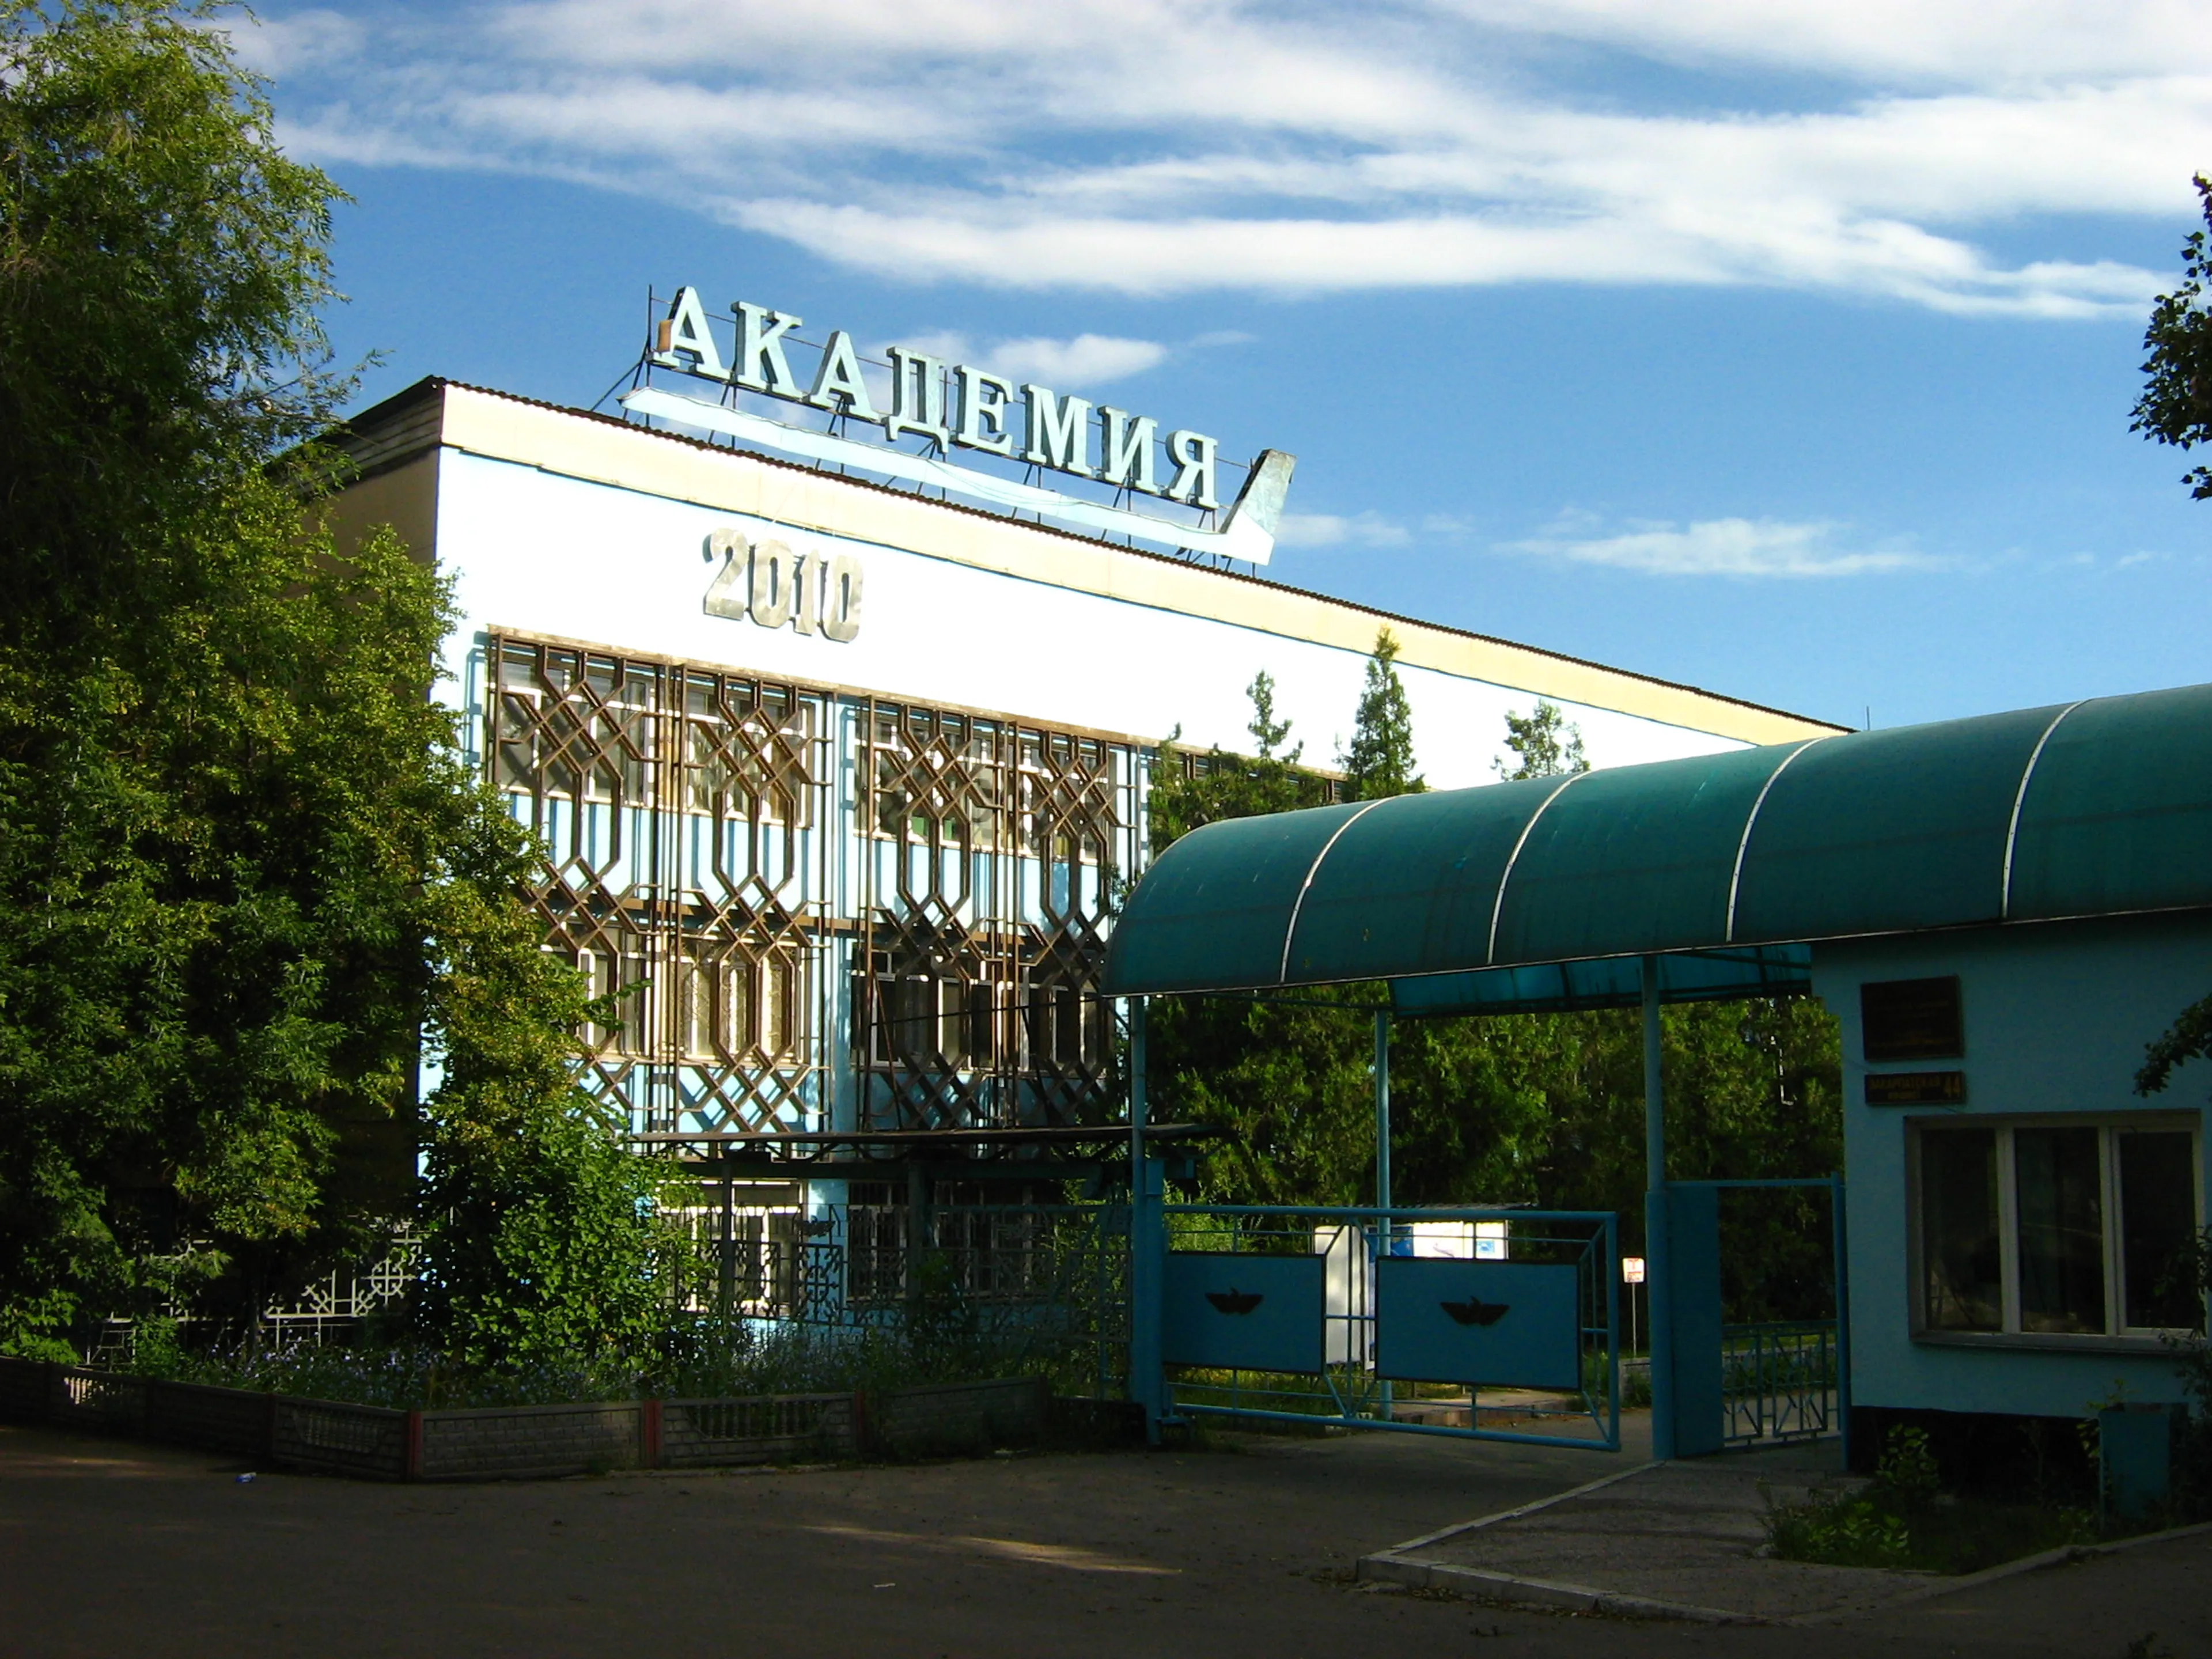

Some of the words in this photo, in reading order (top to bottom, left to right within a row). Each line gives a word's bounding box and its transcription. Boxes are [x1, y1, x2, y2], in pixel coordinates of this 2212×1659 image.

[646, 286, 1218, 510] АКАДЕМИЯ
[702, 527, 864, 644] 2010
[1943, 1075, 1961, 1098] 44
